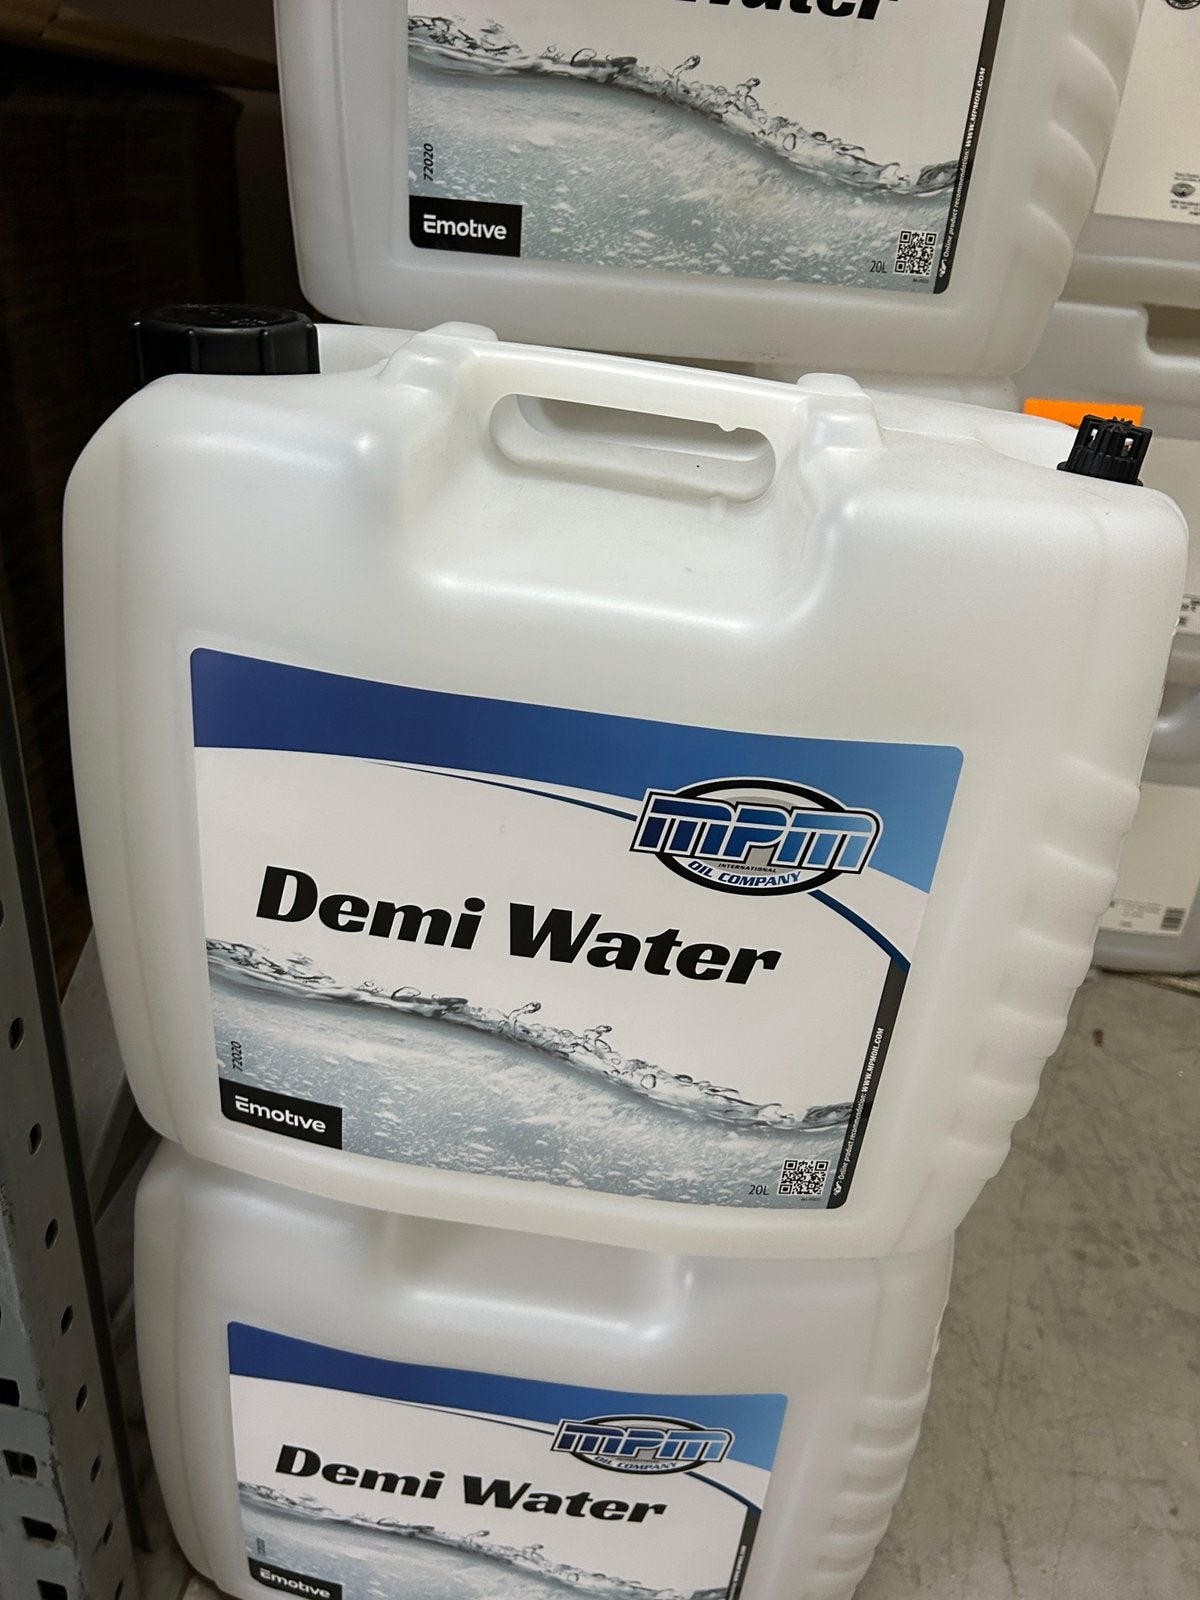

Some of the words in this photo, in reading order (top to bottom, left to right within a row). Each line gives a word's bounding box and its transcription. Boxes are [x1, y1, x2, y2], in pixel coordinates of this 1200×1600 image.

[964, 66, 987, 149] WWW.MPMOIL.COM
[423, 142, 434, 182] 72020
[954, 148, 970, 209] recommendation:
[423, 213, 508, 240] Emotive
[948, 208, 961, 237] product
[942, 236, 954, 258] Online
[869, 259, 888, 274] 20L
[687, 860, 714, 878] OIL
[717, 870, 802, 887] COMPANY
[718, 863, 777, 874] INTERNATIONAL
[255, 864, 486, 951] Demi
[508, 901, 783, 985] Water
[230, 1040, 244, 1072] 72020
[234, 1094, 327, 1133] Emotive
[839, 1157, 849, 1181] Online
[844, 1139, 855, 1164] product
[850, 1090, 867, 1141] recommendation:
[861, 1027, 885, 1093] WWW.MPMOIL.COM
[748, 1184, 770, 1197] 20L
[594, 1456, 613, 1465] OIL
[617, 1461, 678, 1471] COMPANY
[275, 1444, 446, 1500] Demi
[463, 1474, 668, 1523] Water
[260, 1567, 331, 1599] Emotive
